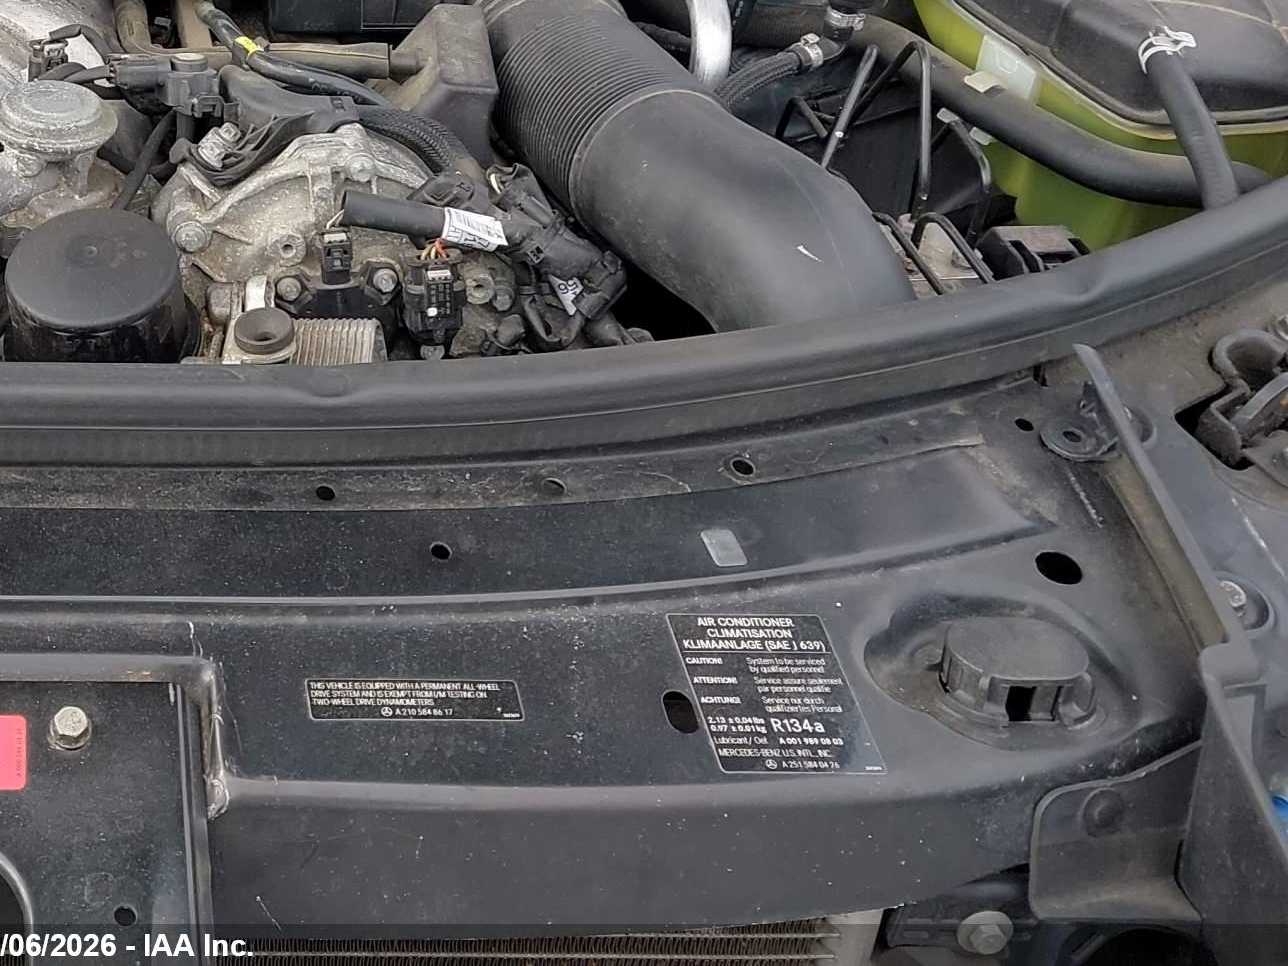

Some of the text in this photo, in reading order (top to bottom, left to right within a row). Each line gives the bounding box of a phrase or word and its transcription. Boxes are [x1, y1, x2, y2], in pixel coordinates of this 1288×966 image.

[697, 618, 795, 627] AIR CONDITIONER
[707, 629, 793, 638] CLIMATISATION
[683, 640, 763, 650] KLIMAANLAGE
[765, 640, 790, 651] (SAE
[800, 640, 826, 652] 639)
[745, 657, 775, 666] System
[760, 666, 790, 674] qualified
[790, 666, 825, 674] personnel
[753, 676, 782, 684] Service
[421, 682, 461, 690] PERMANENT
[311, 690, 331, 698] DRIVE
[332, 690, 361, 698] SYSTEM
[361, 690, 376, 698] AND
[378, 690, 384, 698] IS
[384, 690, 412, 698] EXEMPT
[412, 690, 433, 698] FROM
[761, 696, 790, 704] Service
[401, 708, 417, 716] 210
[417, 708, 432, 716] 584
[812, 705, 843, 713] Personal
[707, 716, 726, 724] 2.13
[756, 725, 767, 733] kg
[770, 718, 826, 733] R134a
[718, 748, 782, 757] MERCEDES-BENZ
[788, 761, 803, 769] 251
[803, 761, 818, 769] 584
